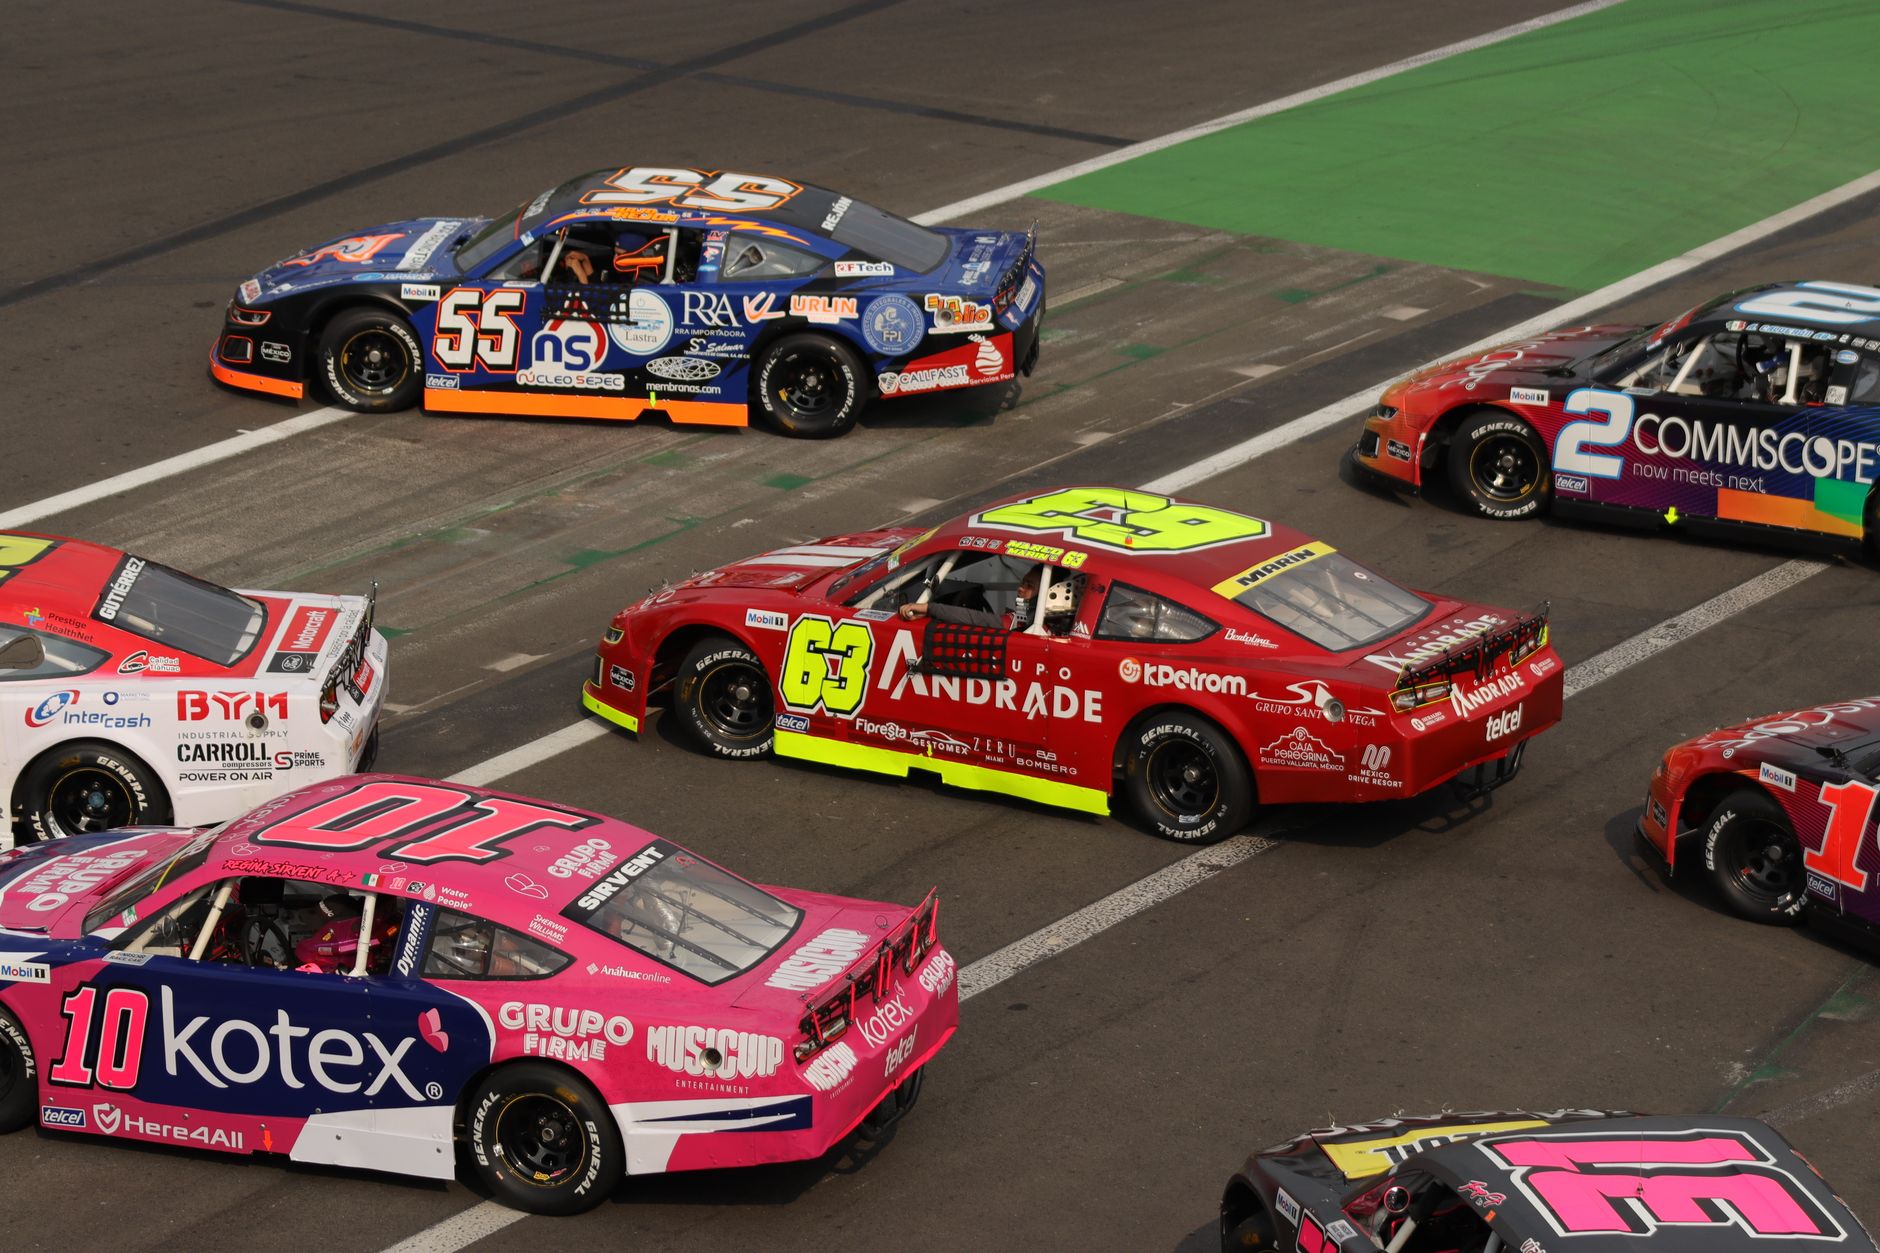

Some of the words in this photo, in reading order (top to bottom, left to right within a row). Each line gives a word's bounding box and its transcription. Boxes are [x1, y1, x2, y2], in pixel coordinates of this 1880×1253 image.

[580, 166, 803, 212] 55
[821, 196, 852, 231] REJÓN
[403, 286, 427, 297] Mobil
[427, 288, 437, 297] 1
[680, 291, 742, 327] RRA
[792, 296, 857, 316] URLIN
[432, 287, 527, 373] 55
[625, 331, 657, 343] Lastra
[674, 328, 688, 336] RRA
[690, 328, 746, 338] IMPORTADORA
[389, 324, 421, 373] GENERAL
[534, 333, 591, 371] ns
[426, 376, 458, 387] telcel
[519, 371, 572, 385] NÚCLEO
[760, 357, 777, 412] GENERAL
[899, 366, 966, 384] CALLFASST
[646, 382, 721, 394] membranas.com
[837, 364, 856, 418] GENERAL
[1511, 390, 1535, 401] Mobil
[1470, 421, 1529, 441] GENERAL
[1552, 387, 1635, 480] 2
[1633, 413, 1874, 484] COMMSCOPE
[1556, 476, 1586, 490] telcel
[1633, 462, 1668, 480] now
[1673, 468, 1723, 487] meets
[1479, 500, 1537, 518] GENERAL
[967, 487, 1272, 555] 63
[99, 557, 146, 620] GUTIÉRREZ
[48, 612, 87, 629] Prestige
[290, 610, 328, 649] Motorcraft
[747, 612, 774, 625] Mobil
[775, 616, 784, 626] 1
[44, 622, 93, 643] HealthNet
[149, 656, 179, 664] Calidad
[695, 650, 760, 671] GENERAL
[778, 613, 876, 720] 63
[877, 629, 1103, 723] ANDRADE
[1450, 671, 1526, 718] ANDRADE
[778, 715, 808, 731] telcel
[1255, 702, 1292, 715] GRUPO
[1349, 713, 1376, 728] VEGA
[1486, 702, 1522, 741] telcel
[178, 730, 244, 739] INDUSTRIAL
[249, 730, 289, 739] SUPPLY
[1140, 724, 1201, 745] GENERAL
[177, 742, 272, 762] CARROLL
[294, 748, 320, 759] PRIME
[911, 737, 969, 756] GESTOMEX
[973, 736, 1016, 758] ZERU
[222, 760, 272, 769] compressors
[294, 759, 326, 768] SPORTS
[985, 755, 1005, 763] MIAMI
[1016, 757, 1078, 775] BOMBERG
[1261, 756, 1286, 765] PUERTO
[96, 756, 148, 811] GENERAL
[178, 772, 228, 785] POWER
[231, 772, 250, 783] ON
[252, 771, 273, 782] AIR
[1348, 774, 1369, 784] DRIVE
[1372, 778, 1403, 789] RESORT
[1761, 767, 1784, 784] Mobil
[1784, 775, 1793, 787] 1
[1157, 820, 1217, 839] GENERAL
[1706, 810, 1736, 870] GENERAL
[1803, 779, 1879, 893] 1
[548, 838, 612, 879] GRUPO
[270, 861, 326, 879] SIRVENT
[577, 846, 665, 911] SIRVENT
[441, 886, 469, 899] Water
[1808, 875, 1833, 896] telcel
[535, 914, 568, 934] SHERWIN
[397, 904, 424, 977] Dynamic
[1, 965, 33, 977] Mobil
[35, 968, 46, 979] 1
[919, 949, 955, 992] GRUPO
[498, 1001, 634, 1046] GRUPO
[856, 996, 914, 1049] kotex
[50, 985, 149, 1089] 10
[161, 984, 427, 1101] kotex
[523, 1033, 607, 1062] FIRME
[0, 1018, 36, 1078] ENERAL
[884, 1024, 918, 1077] telcel
[675, 1079, 750, 1095] ENTERTAINMENT
[44, 1108, 83, 1124] telcel
[124, 1114, 243, 1149] Here4All
[473, 1091, 501, 1166] GENERAL
[574, 1120, 601, 1195] GENERAL
